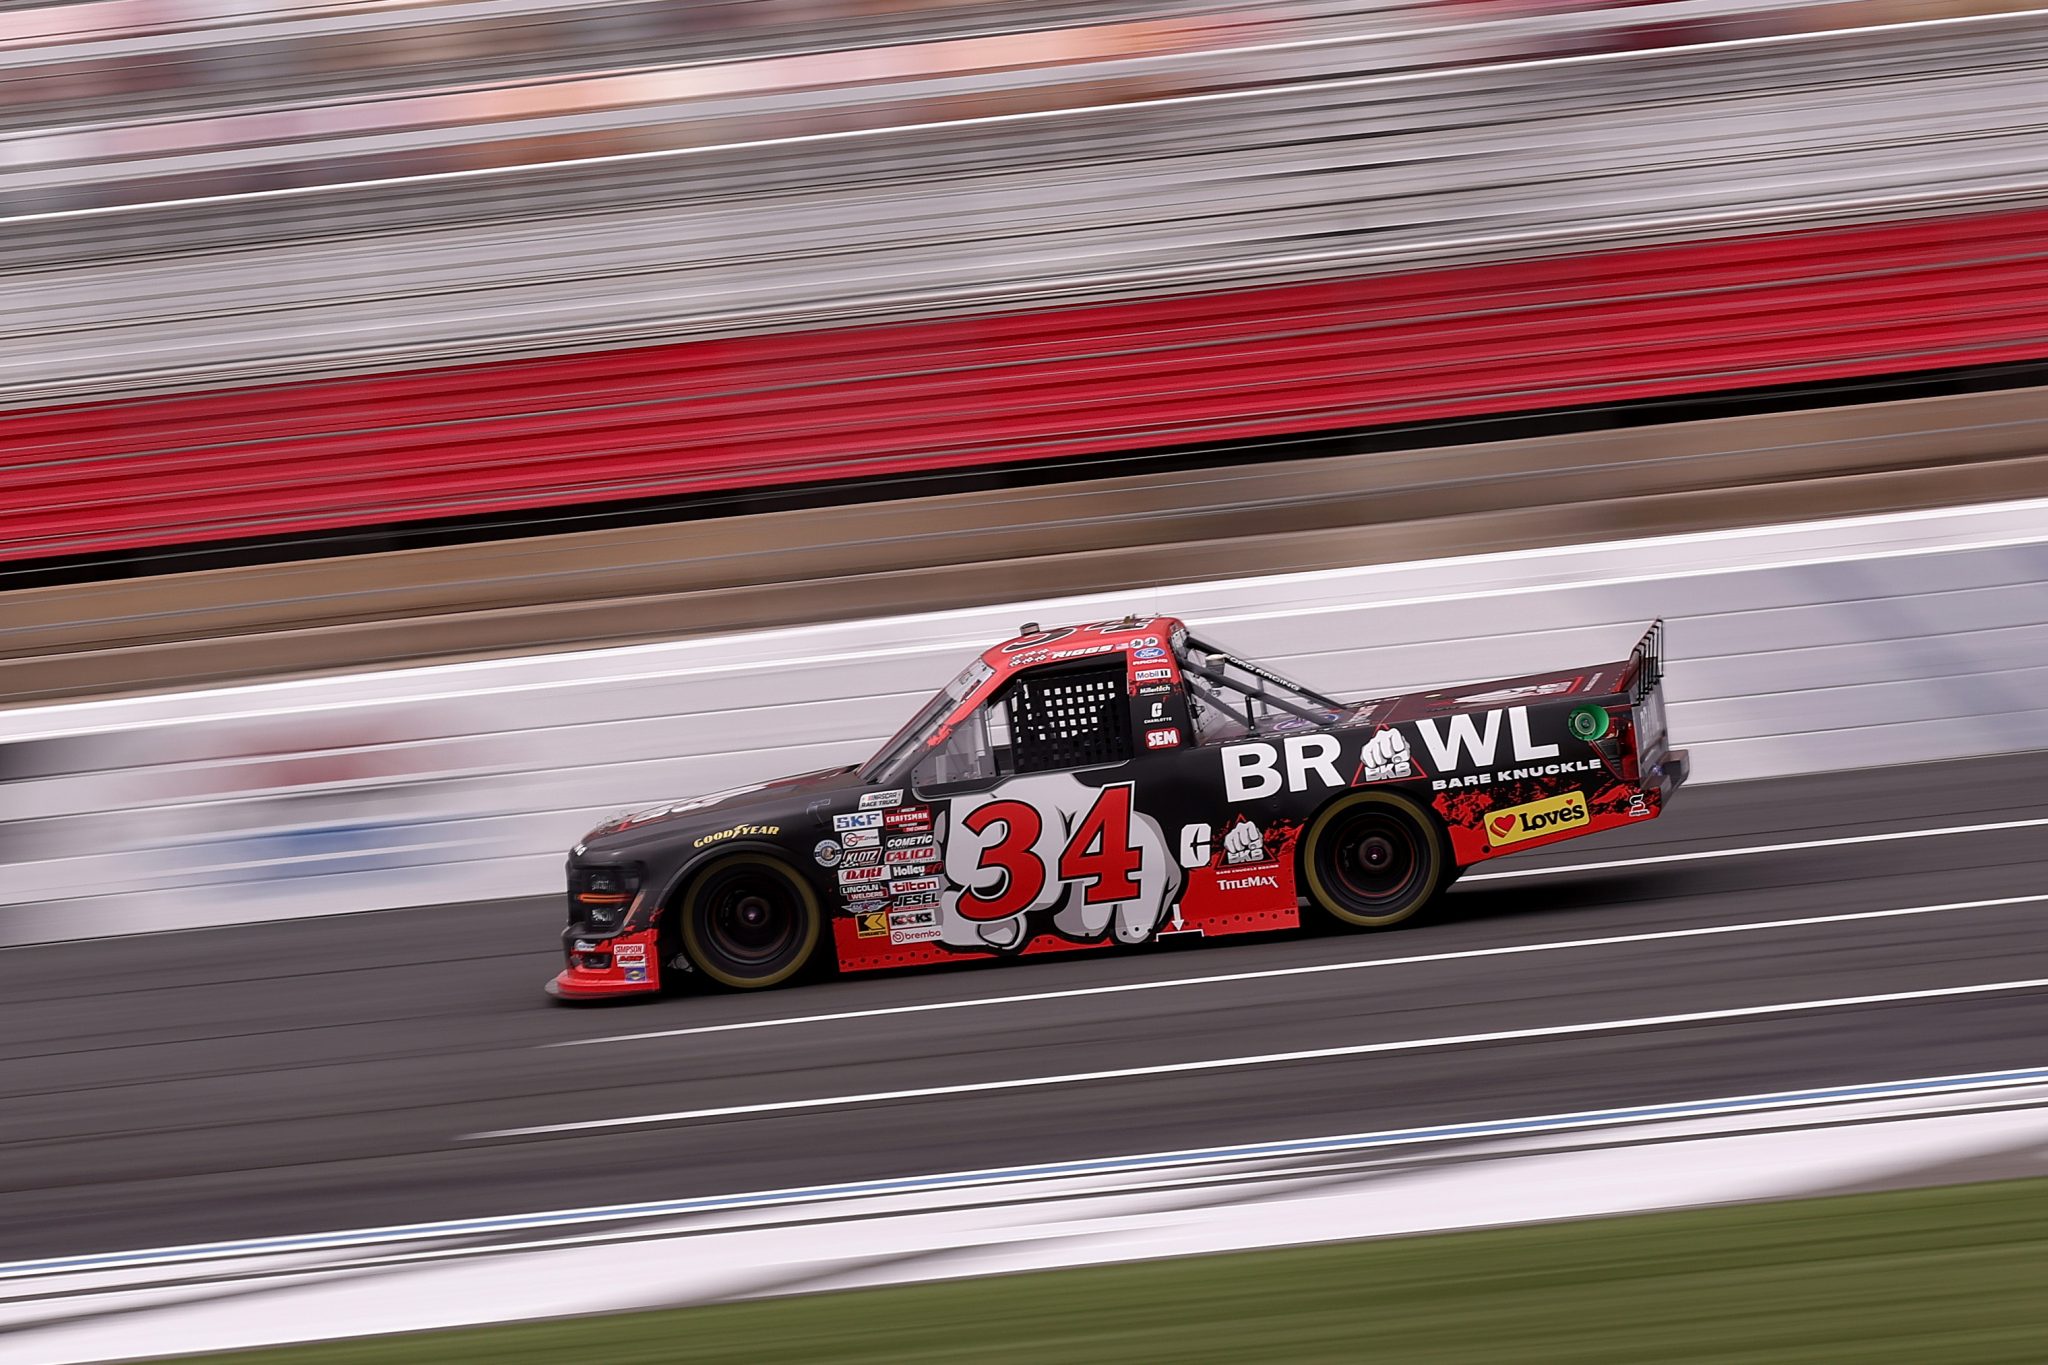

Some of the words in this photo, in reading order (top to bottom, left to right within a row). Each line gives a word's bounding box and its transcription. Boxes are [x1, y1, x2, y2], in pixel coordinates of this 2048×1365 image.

[1051, 644, 1114, 659] RIGGS
[1136, 670, 1160, 679] Mobil
[1222, 653, 1256, 672] FORD
[1256, 667, 1301, 692] RACING
[1147, 730, 1178, 747] SEM
[1364, 762, 1412, 782] BKB
[1431, 773, 1492, 791] BARE
[1498, 759, 1602, 782] KNUCKLE
[879, 799, 899, 807] TRUCK
[836, 813, 880, 829] SKF
[886, 812, 928, 823] CRAFTSMAN
[692, 823, 780, 849] GOODYEAR
[887, 834, 933, 848] COMETIC
[845, 850, 879, 864] KLOTZ
[886, 847, 935, 862] CALICO
[954, 780, 1144, 925] 34
[1227, 848, 1264, 864] BKB
[892, 865, 925, 877] Holley
[842, 884, 879, 894] LINCOLN
[892, 881, 937, 892] tilton
[851, 891, 884, 900] WELDERS
[893, 893, 940, 907] JESEL
[890, 913, 932, 926] KOOKS
[904, 930, 941, 940] brembo
[615, 945, 643, 953] SIMPSON
